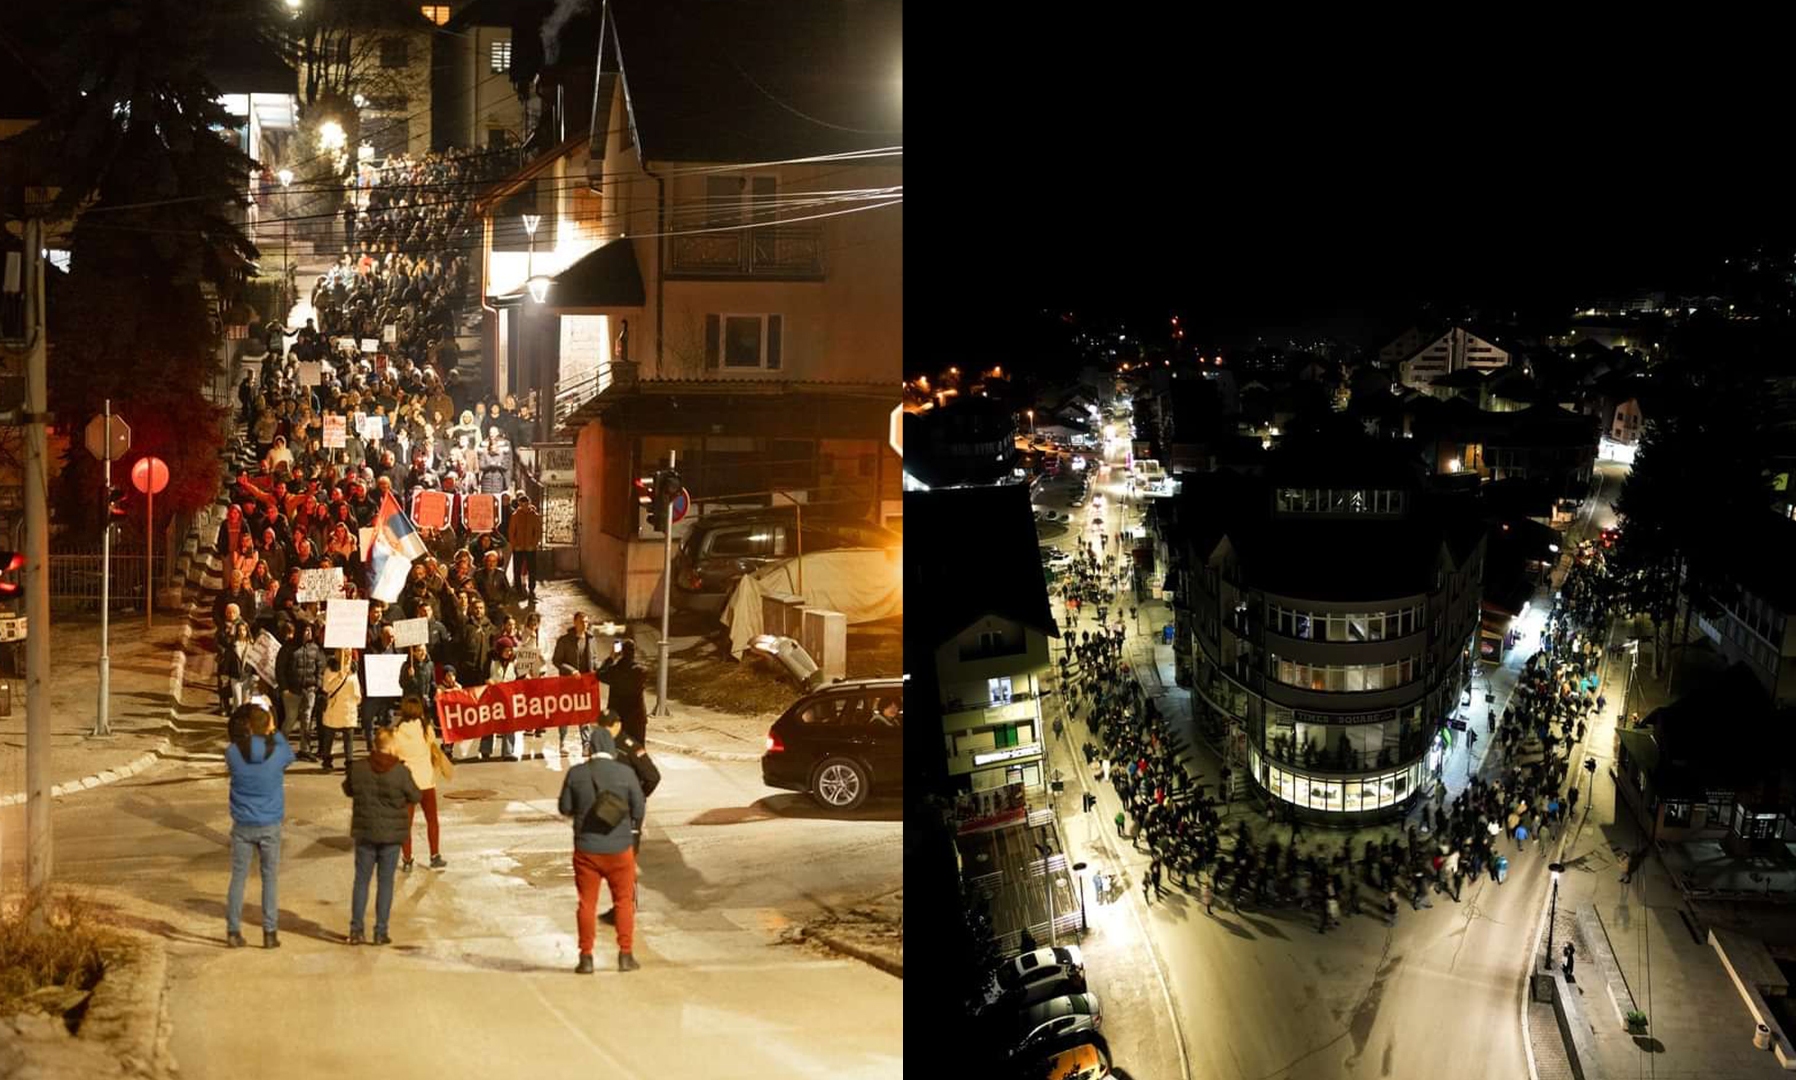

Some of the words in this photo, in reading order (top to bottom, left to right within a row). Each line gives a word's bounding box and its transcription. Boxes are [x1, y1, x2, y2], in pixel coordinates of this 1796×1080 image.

[444, 701, 506, 730] Нова
[512, 692, 592, 719] Варош
[1296, 712, 1329, 723] TIMES
